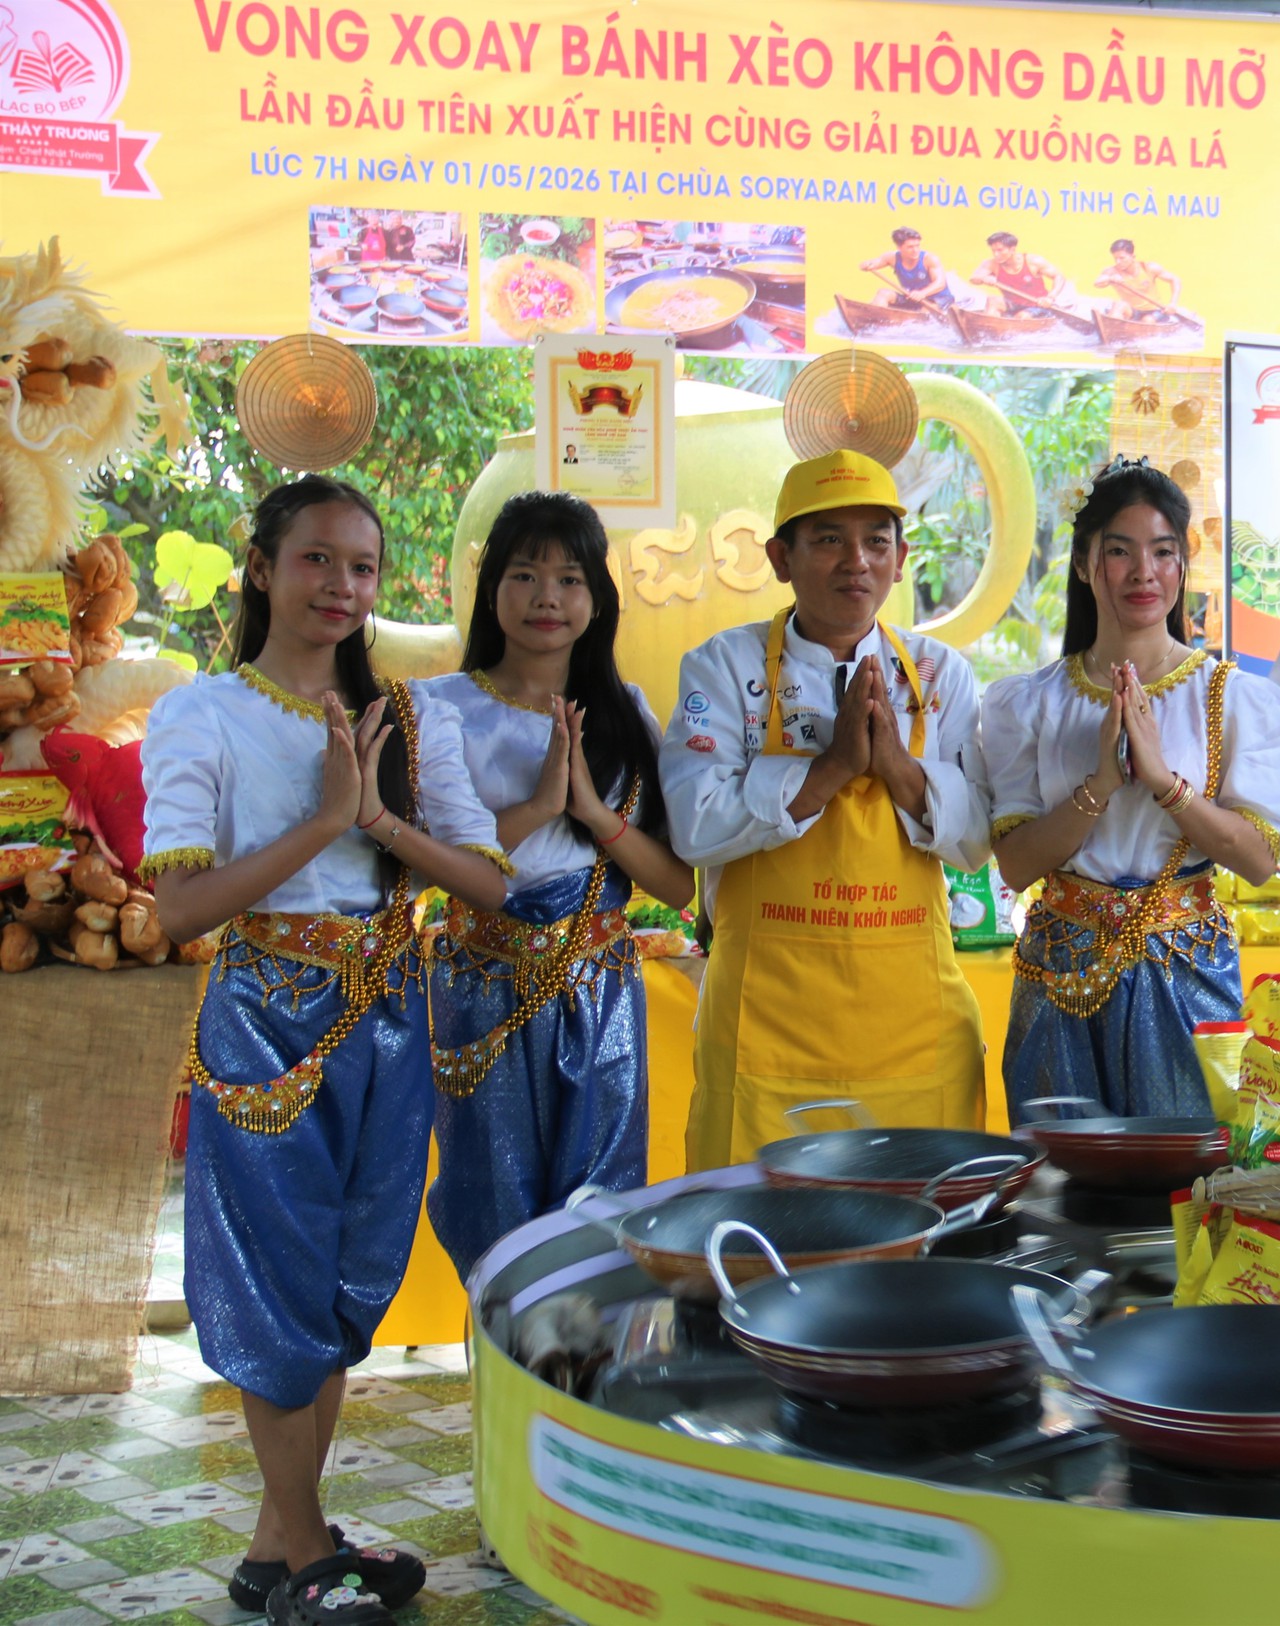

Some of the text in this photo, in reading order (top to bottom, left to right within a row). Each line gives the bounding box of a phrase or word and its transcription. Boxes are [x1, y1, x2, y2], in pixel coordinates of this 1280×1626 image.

[390, 13, 541, 74] XOAY
[562, 14, 706, 84] BÁNH
[727, 21, 833, 89] XÈO
[854, 31, 1044, 99] KHÔNG
[1063, 28, 1166, 104] DẦU
[1186, 48, 1267, 110] MỠ
[240, 72, 1228, 169] LẦN ĐẦU TIÊN XUẤT HIỆN CÙNG GIẢI ĐUA XUỒNG BA LÁ
[250, 145, 1221, 219] LÚC 7H NGÀY 01/05/2026 TẠI CHÙA SORYARAM (CHÙA GIỮA) TỈNH CÀ MAU
[761, 902, 928, 928] THANH NIÊN KHỞI NGHIỆP
[813, 878, 898, 905] TỔ HỢP TÁC
